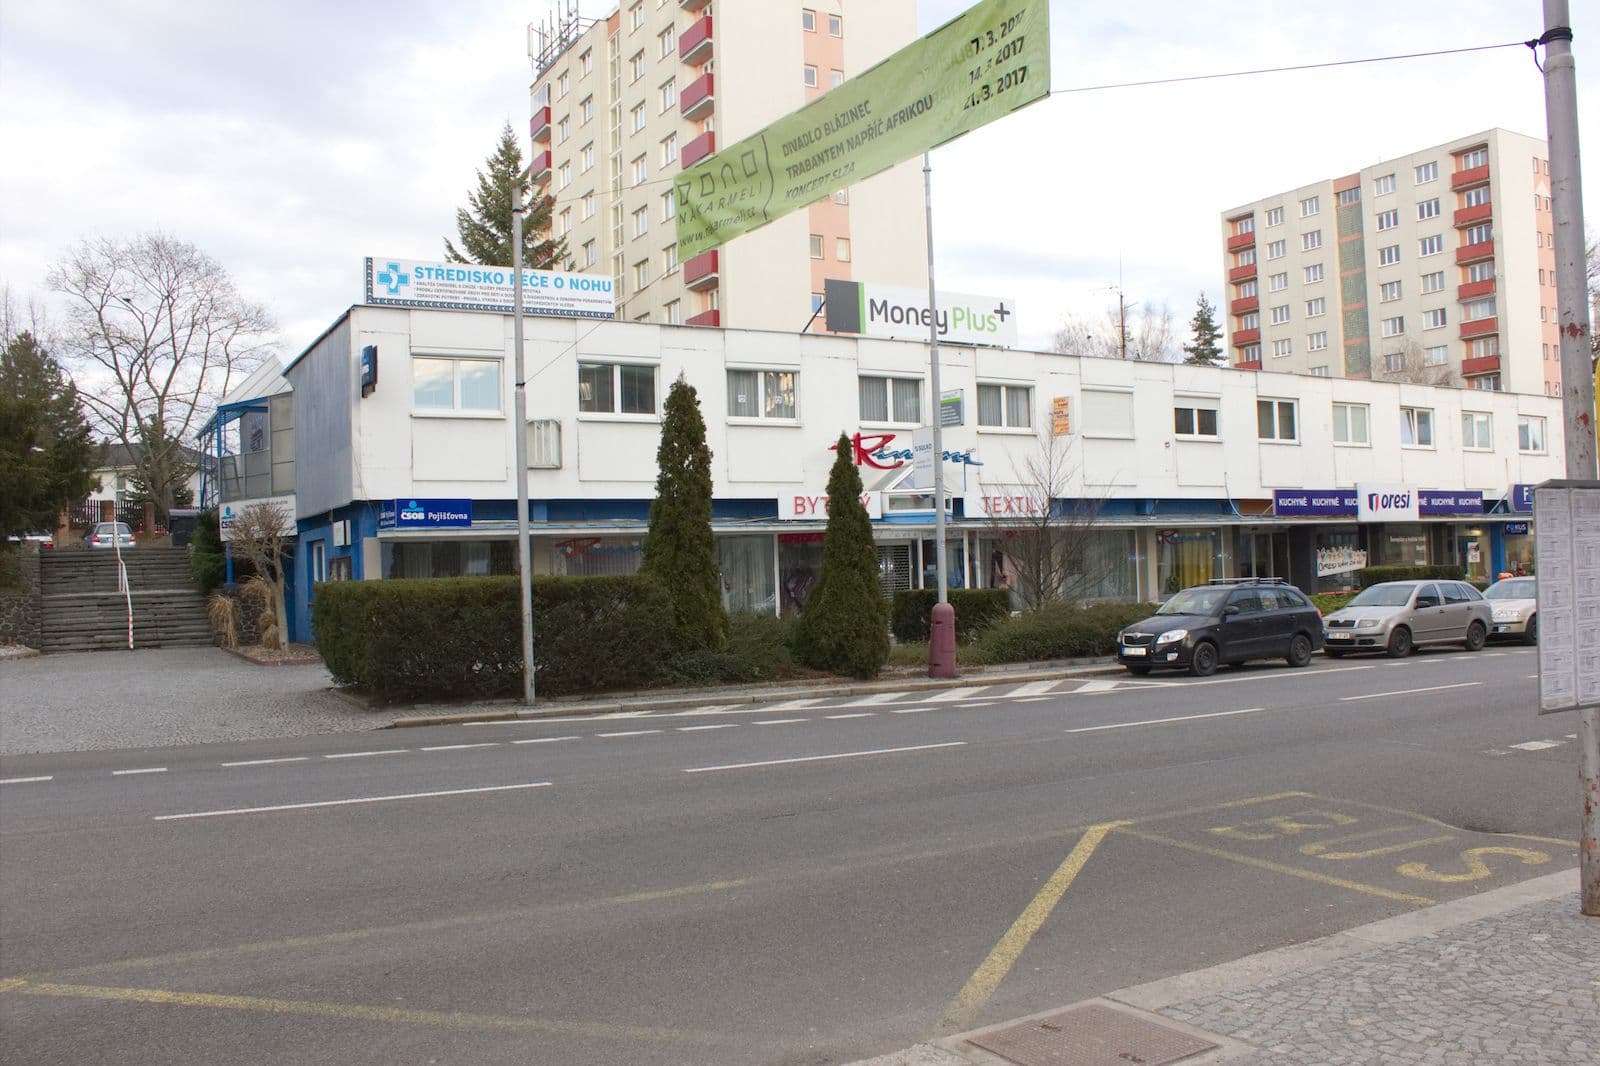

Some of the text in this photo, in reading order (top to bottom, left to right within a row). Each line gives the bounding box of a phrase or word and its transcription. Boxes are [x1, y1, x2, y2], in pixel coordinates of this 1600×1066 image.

[986, 30, 998, 47] 3.
[995, 36, 1025, 65] 2017
[982, 84, 994, 101] 3.
[997, 65, 1027, 94] 2017
[782, 99, 872, 157] DIVADLO BLÁZINEC
[785, 94, 933, 180] TRABANTEM NAPŘÍČ AFRIKOU
[414, 264, 504, 285] STŘEDISKO
[554, 276, 564, 289] O
[569, 277, 612, 292] NOHU
[981, 496, 1039, 513] TEXTIL
[1278, 496, 1308, 507] KUCHYNĚ
[1312, 496, 1340, 507] KUCHYNĚ
[1381, 490, 1411, 509] oresi
[428, 510, 468, 523] Pojišťovna
